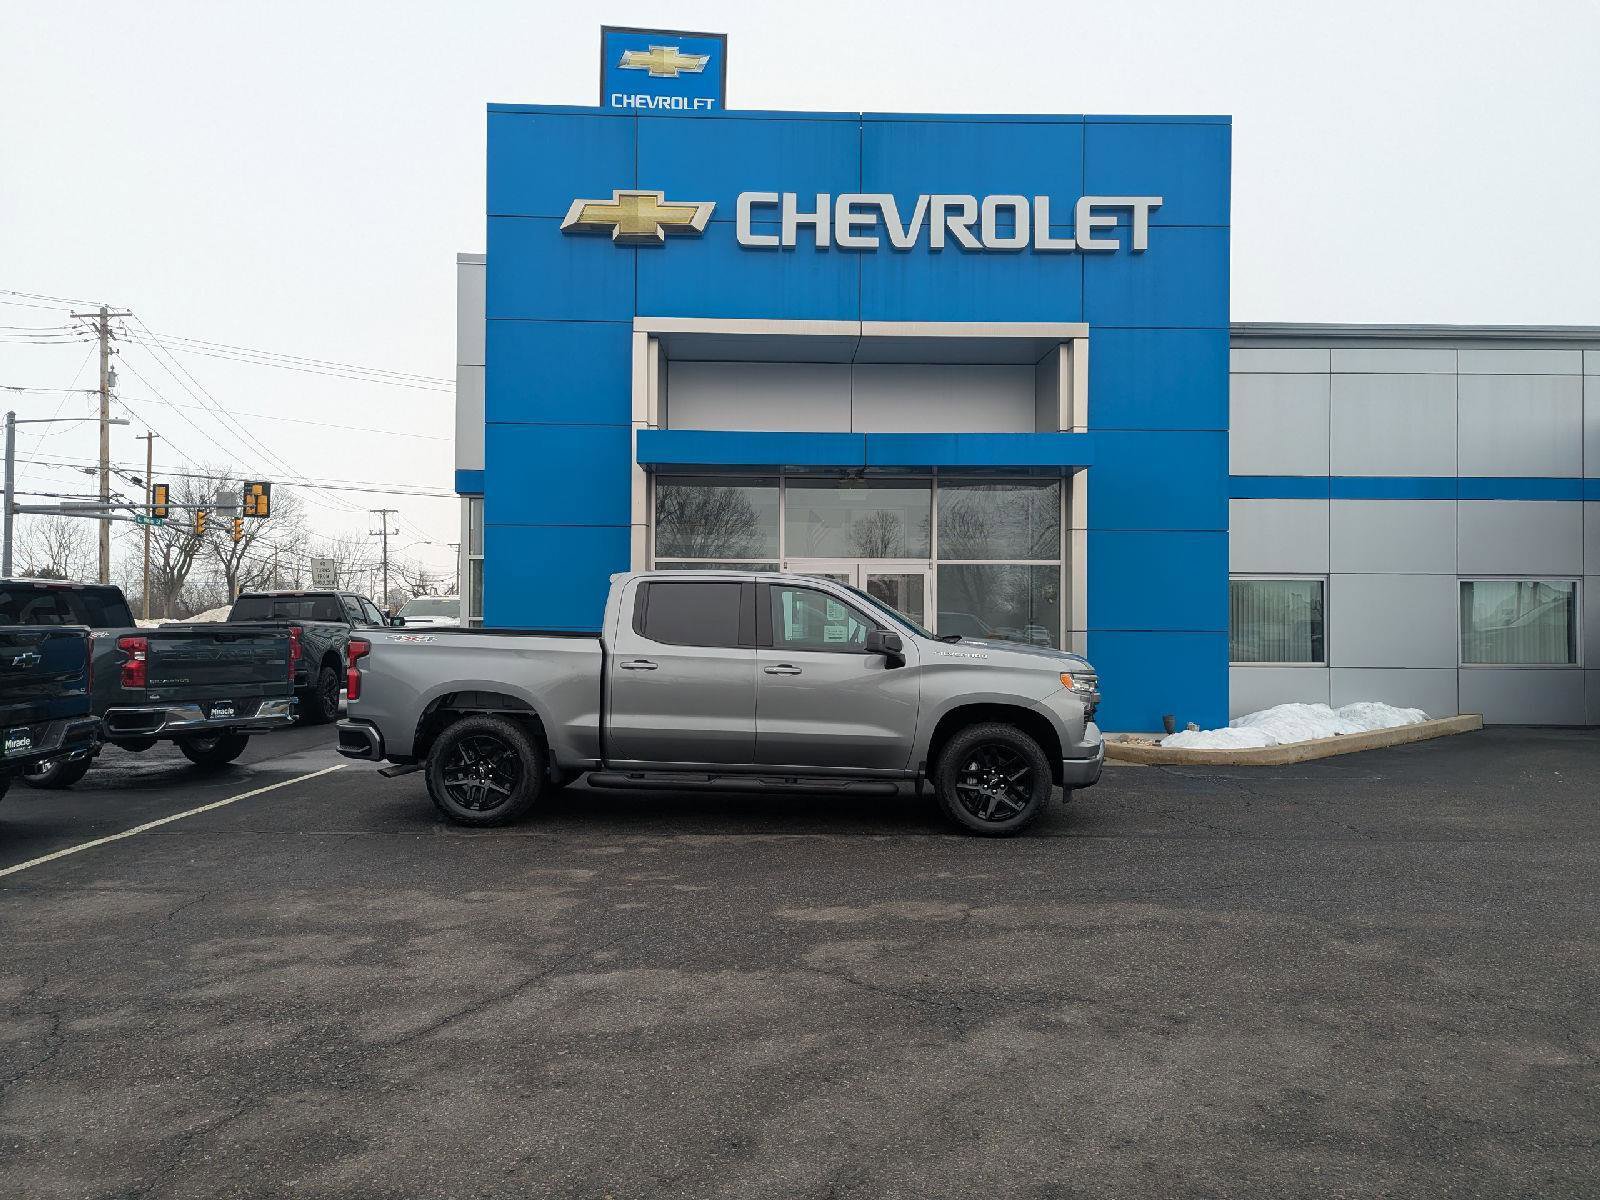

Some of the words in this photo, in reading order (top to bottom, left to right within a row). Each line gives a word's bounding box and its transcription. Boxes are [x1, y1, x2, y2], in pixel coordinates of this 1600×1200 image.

[611, 93, 715, 110] CHEVROLET
[736, 191, 1163, 252] CHEVROLET
[210, 707, 235, 716] Miracle
[5, 737, 31, 749] Miracle
